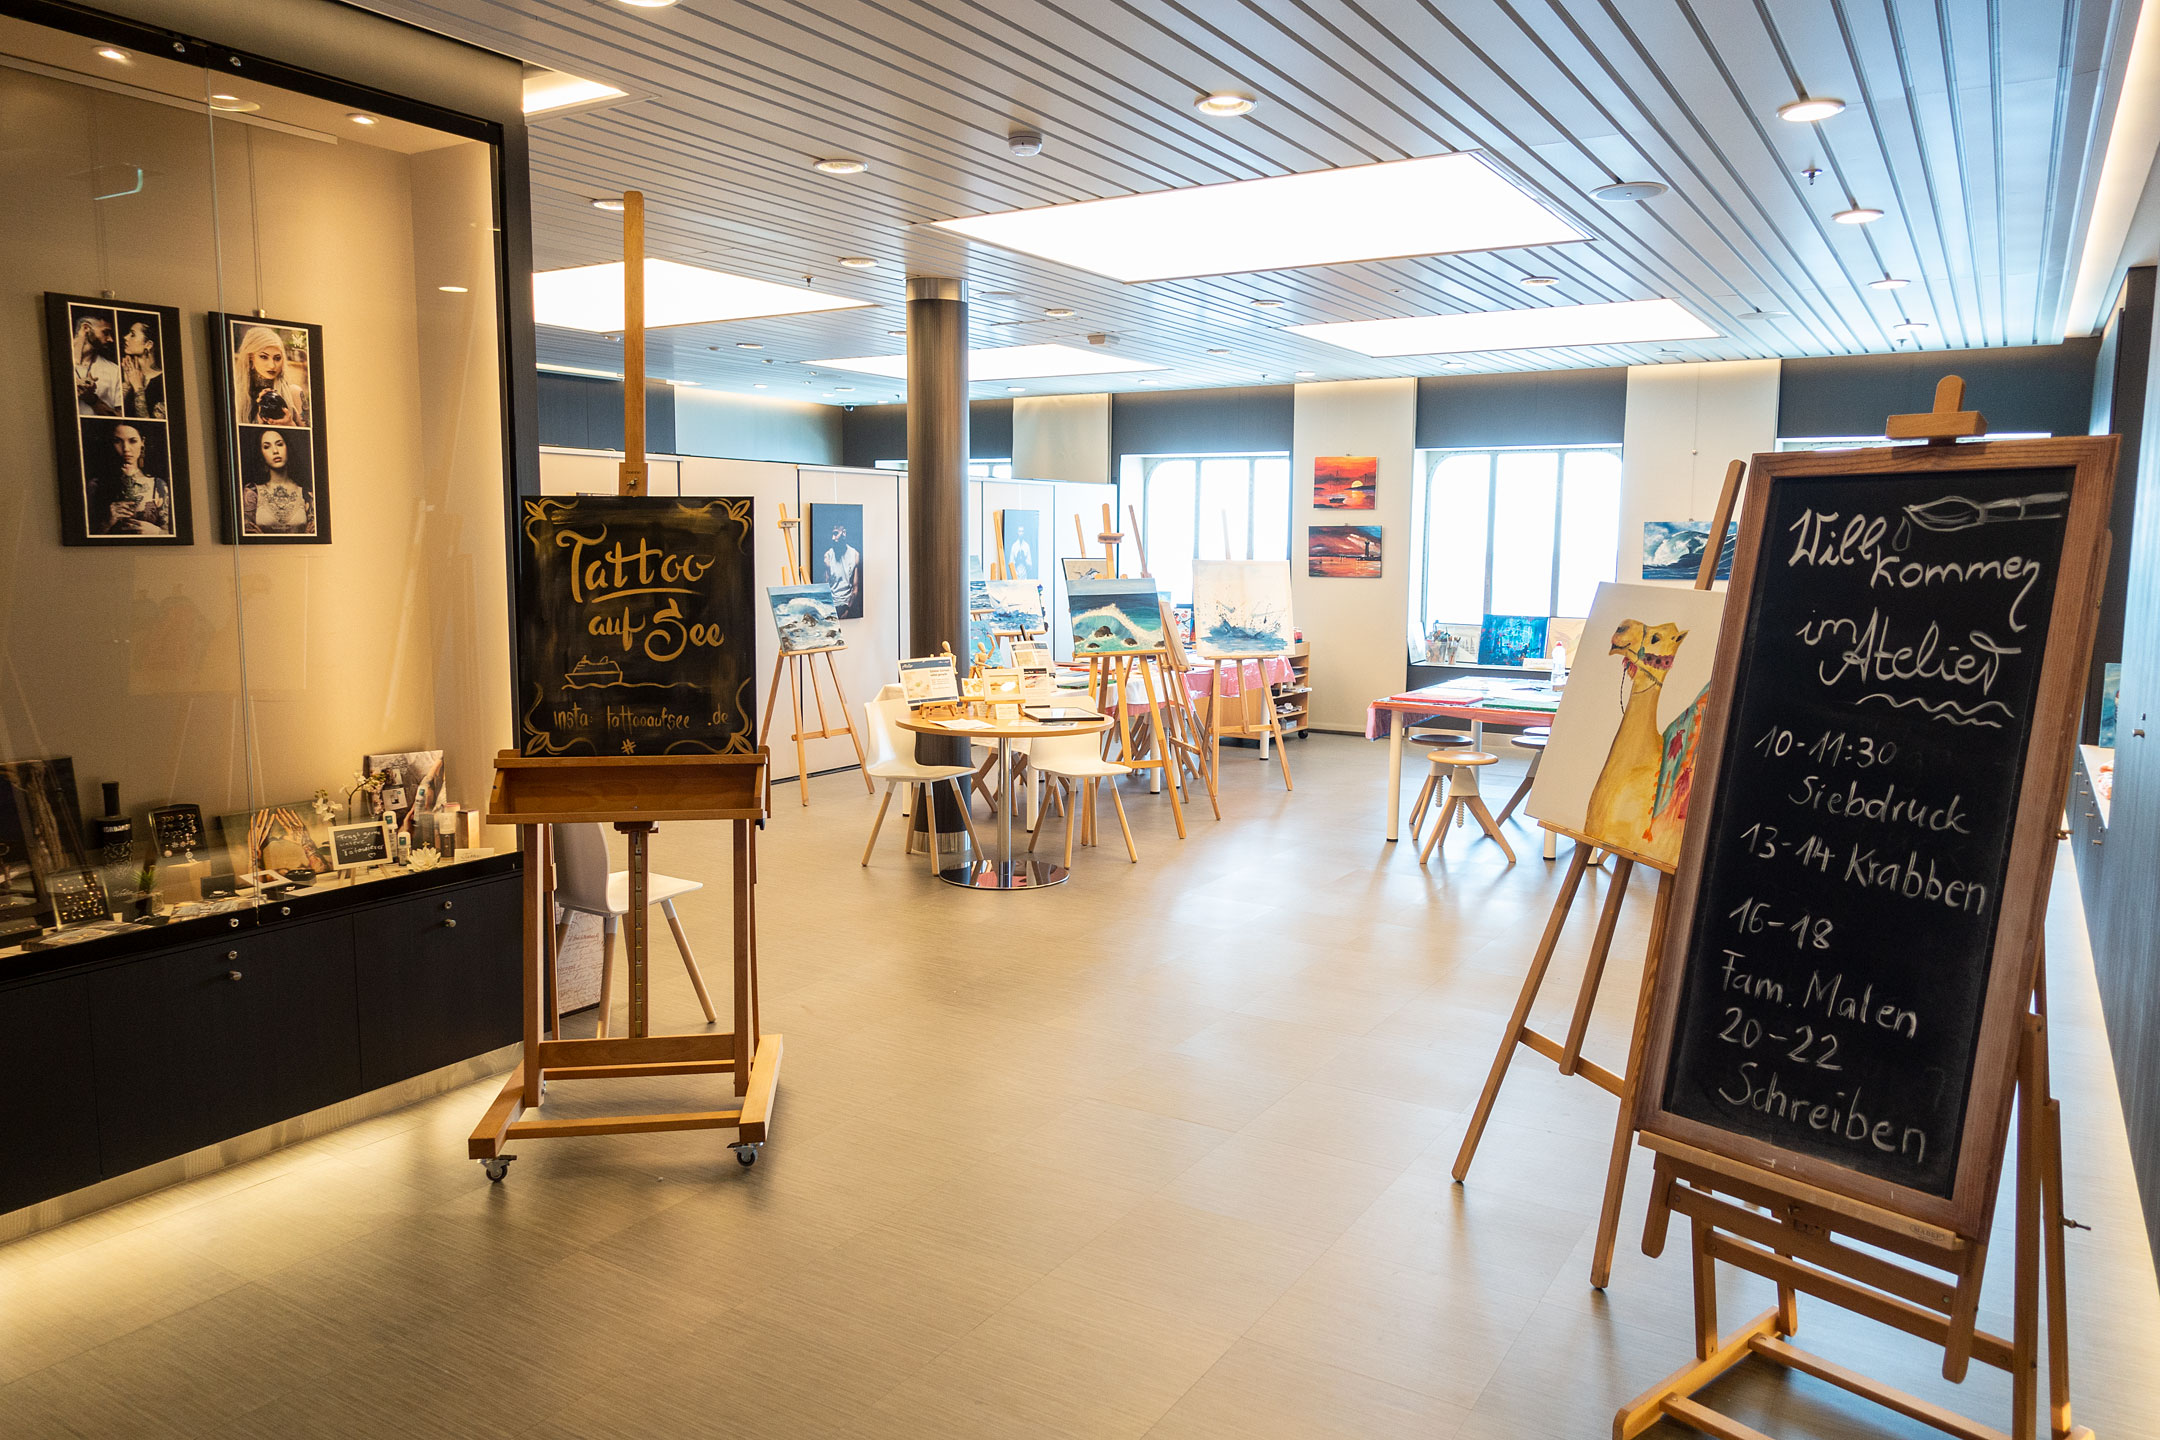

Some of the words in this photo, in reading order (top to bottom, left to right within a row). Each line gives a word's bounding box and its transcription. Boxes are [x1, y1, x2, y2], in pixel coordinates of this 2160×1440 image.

[556, 523, 716, 604] Tattoo
[1788, 507, 1887, 567] Will
[588, 606, 646, 651] auf
[644, 597, 725, 662] See
[1818, 606, 2022, 696] Atelier
[1788, 775, 1972, 834] Siebdruck
[1739, 822, 1836, 873] 13-14
[1843, 843, 1986, 916] Krabben
[1717, 1006, 1842, 1071] 20-22
[1803, 970, 1918, 1039] Malen
[1718, 1062, 1926, 1163] Schreiben
